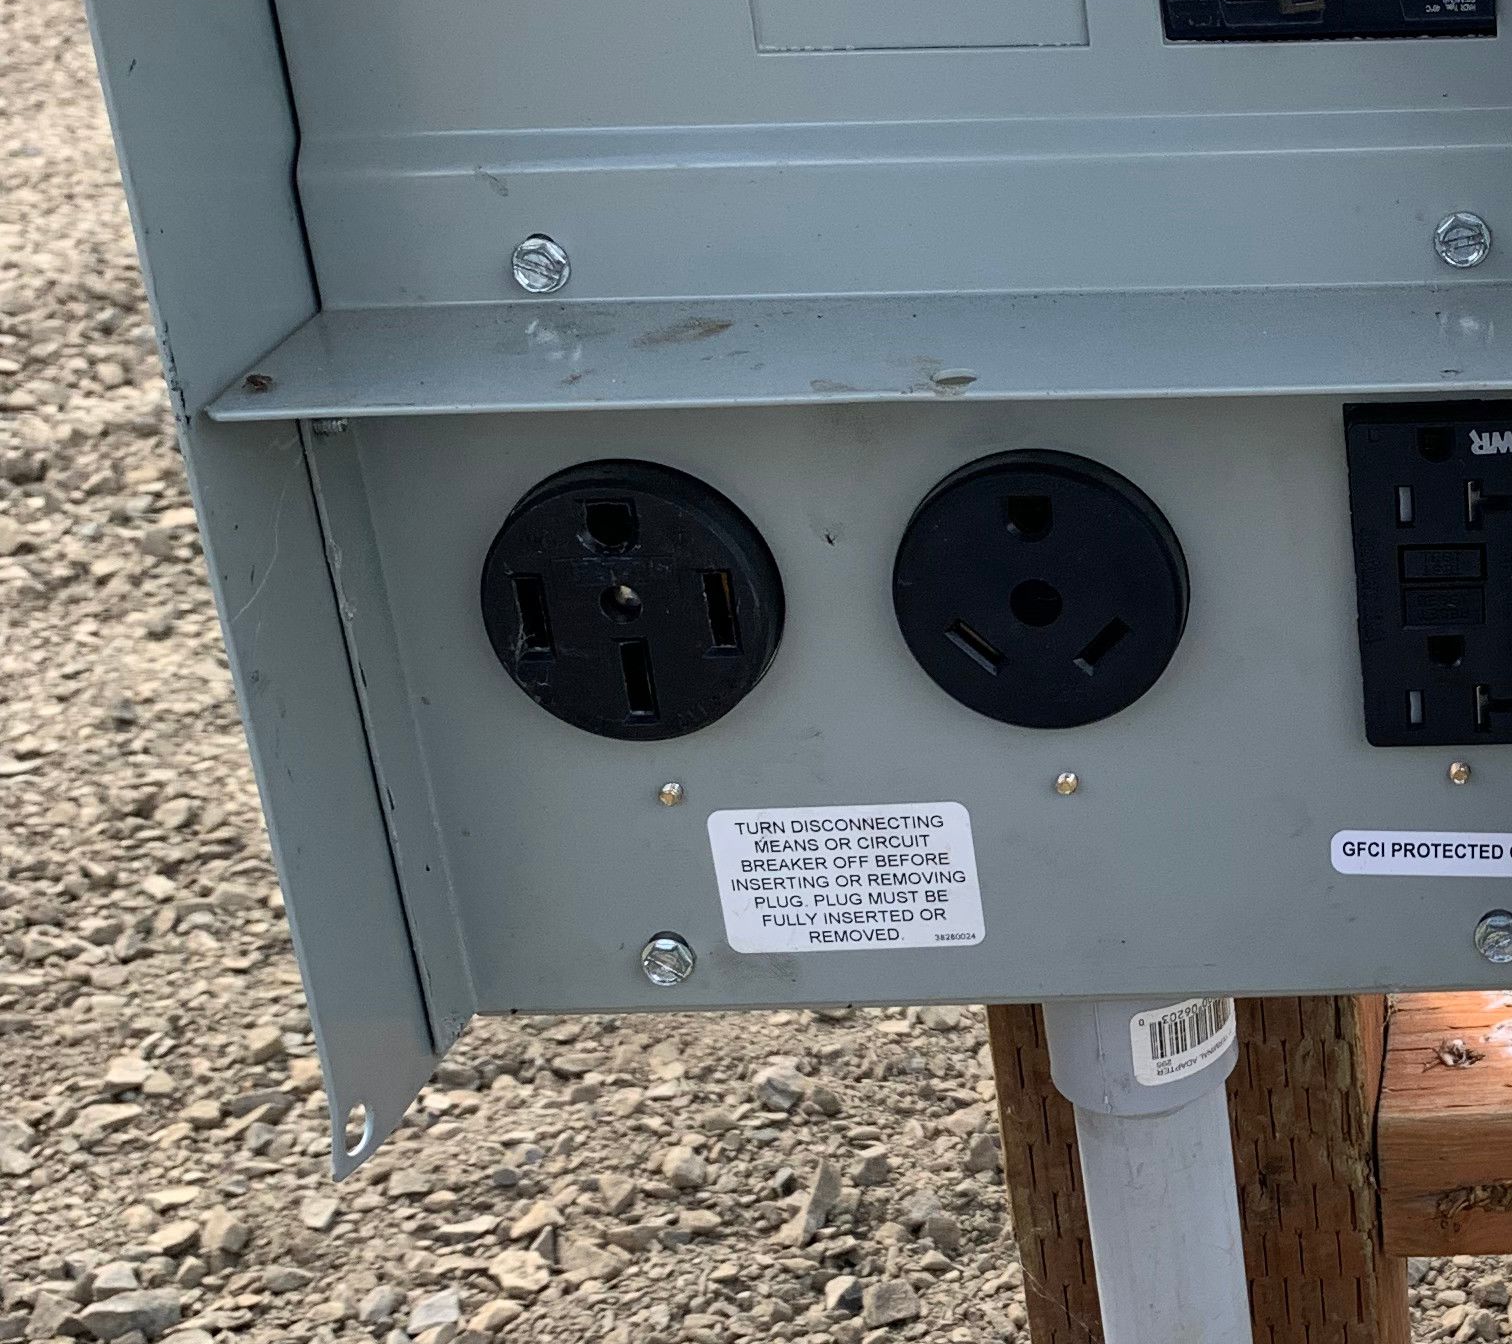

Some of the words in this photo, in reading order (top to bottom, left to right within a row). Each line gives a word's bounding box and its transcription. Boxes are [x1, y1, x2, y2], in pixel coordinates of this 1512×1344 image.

[734, 821, 785, 835] TURN
[790, 815, 944, 834] DISCONNECTING
[754, 839, 819, 854] MEANS
[825, 838, 851, 851] OR
[857, 834, 930, 850] CIRCUIT
[1342, 841, 1385, 858] GFCI
[1391, 842, 1503, 860] PROTECTED
[741, 857, 827, 872] BREAKER
[833, 856, 869, 869] OFF
[875, 852, 950, 868] BEFORE
[731, 875, 829, 892] INSERTING
[835, 875, 862, 888] OR
[868, 871, 966, 886] REMOVING
[814, 893, 862, 907] PLUG
[869, 890, 918, 905] MUST
[925, 890, 949, 903] BE
[763, 912, 817, 927] FULLY
[824, 909, 914, 925] INSERTED
[920, 909, 946, 921] OR
[809, 928, 905, 944] REMOVED.
[1138, 1018, 1145, 1026] 0
[1161, 1004, 1198, 1024] 06203
[1157, 1057, 1198, 1076] ADAPTER
